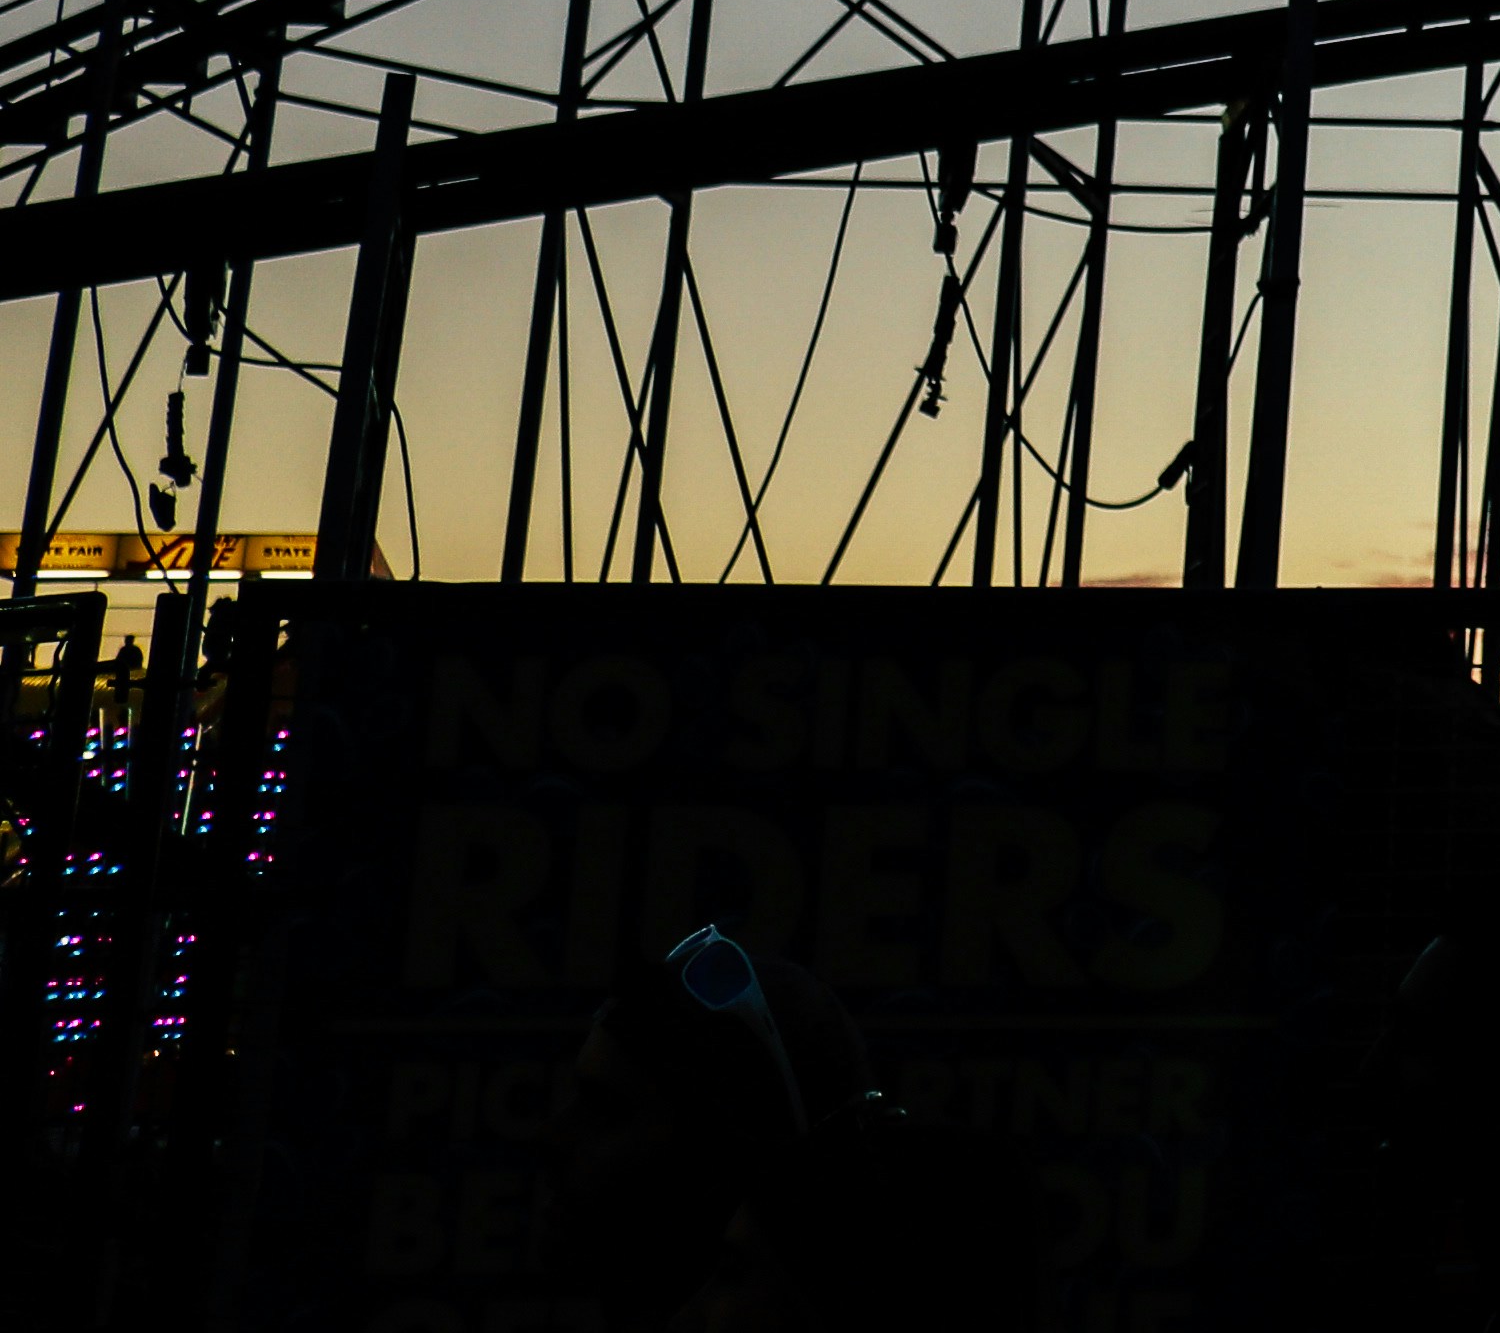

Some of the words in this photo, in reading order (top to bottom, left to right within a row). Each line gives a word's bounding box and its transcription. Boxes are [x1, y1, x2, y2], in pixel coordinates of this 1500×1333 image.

[262, 546, 312, 558] STATE
[426, 655, 672, 772] NO
[726, 656, 1234, 773] SINGLE
[402, 802, 1228, 993] RIDERS
